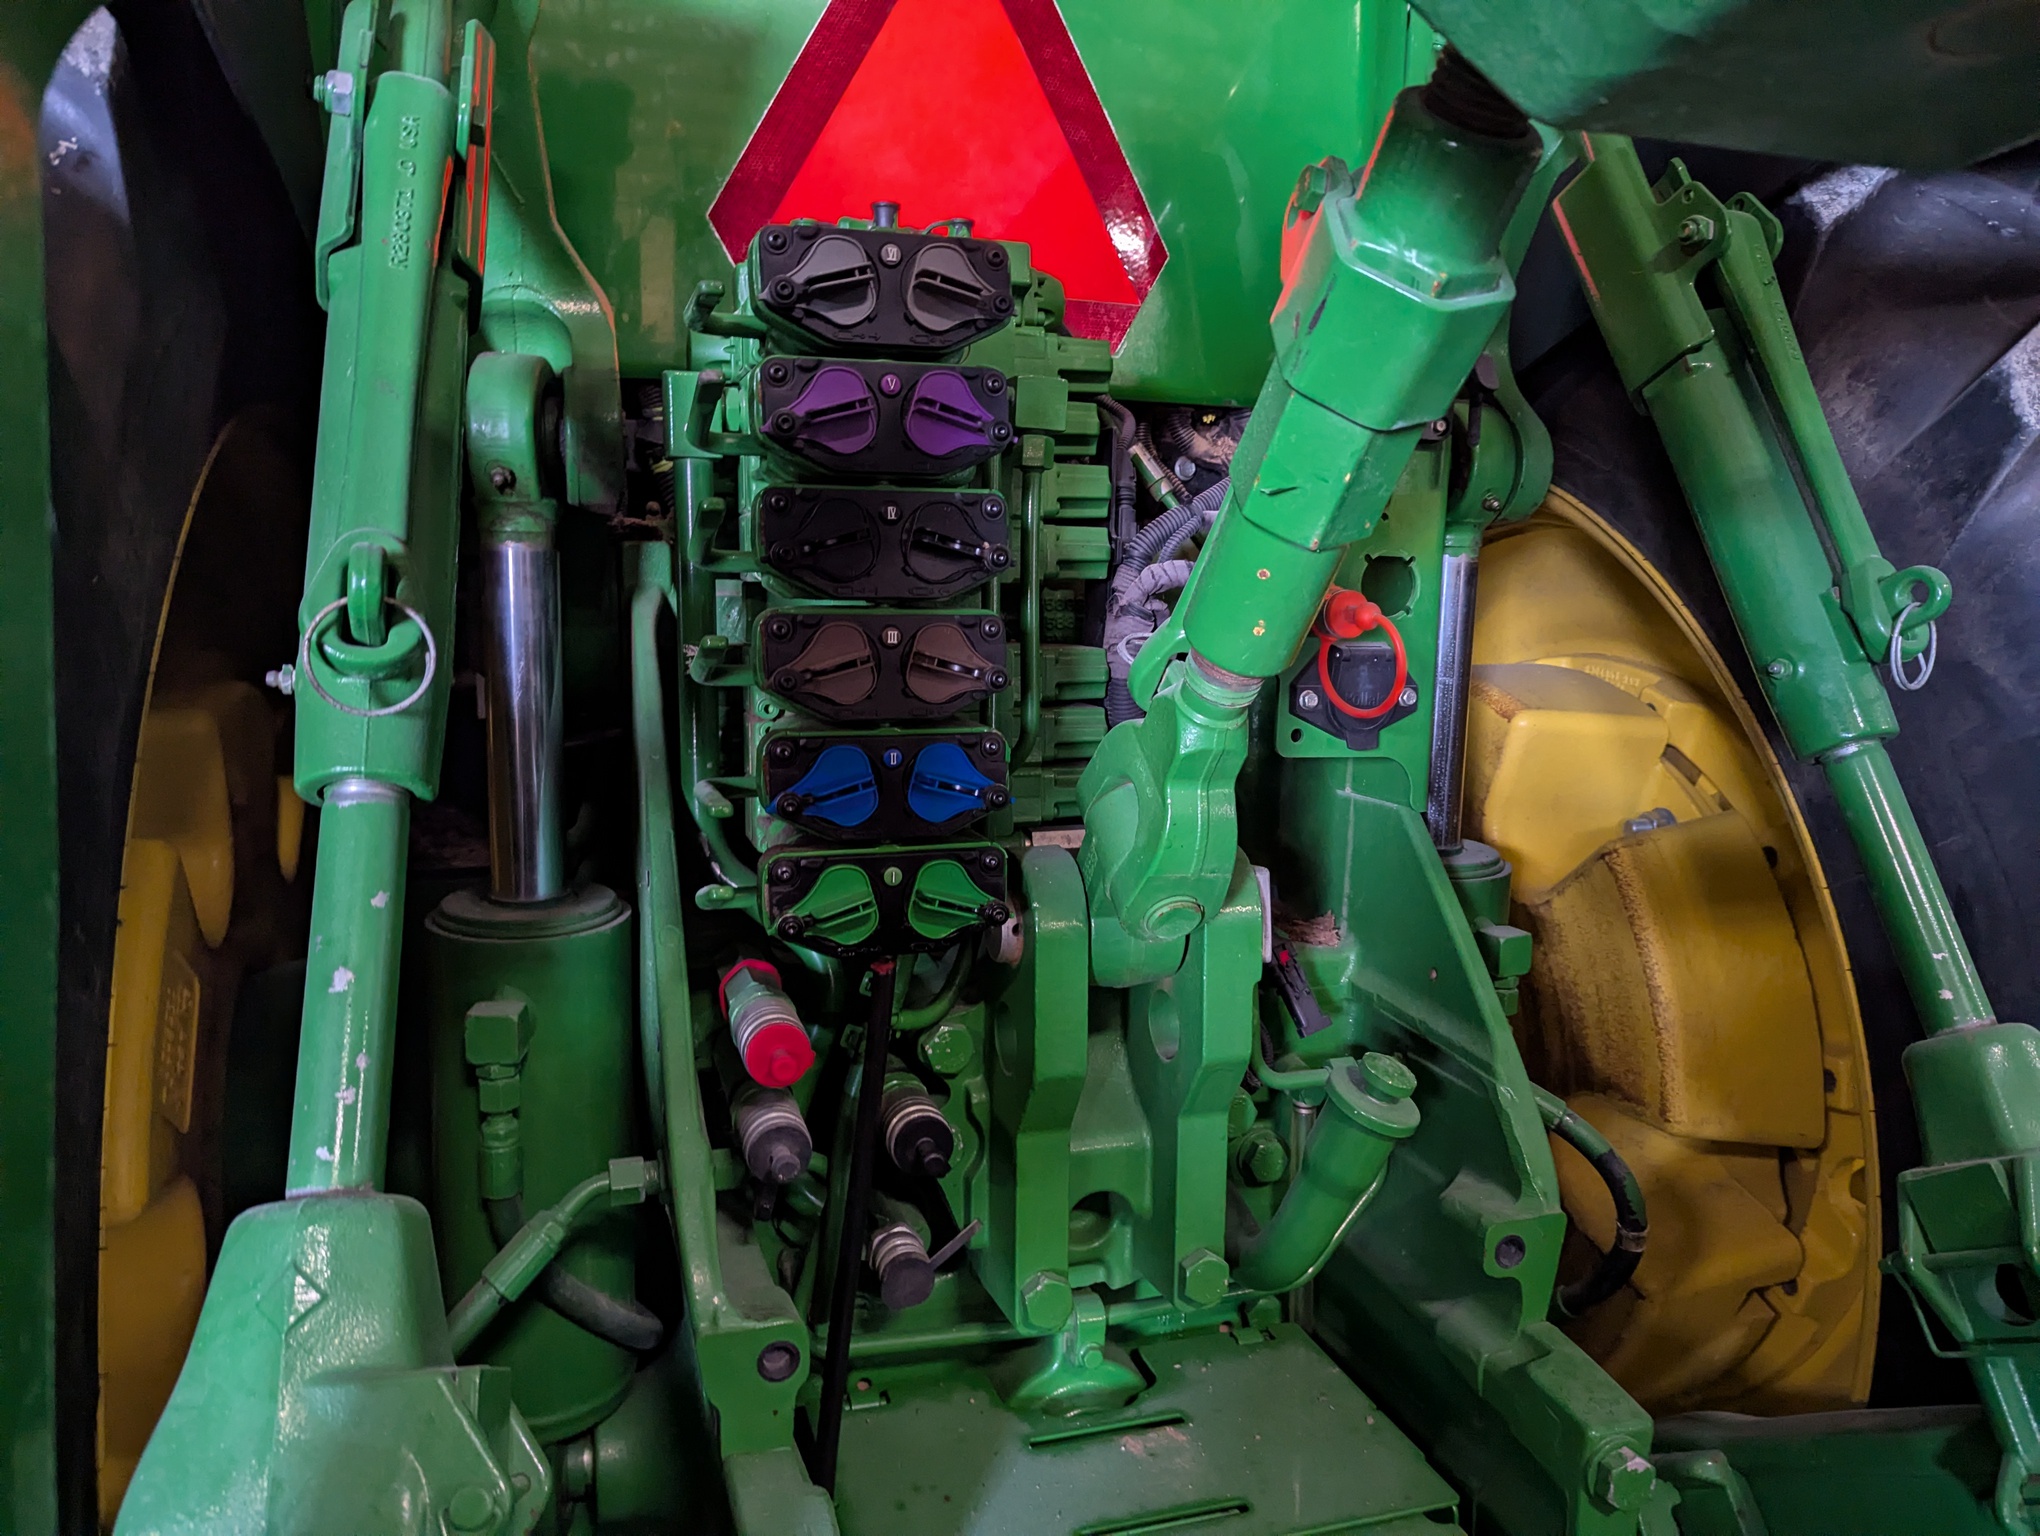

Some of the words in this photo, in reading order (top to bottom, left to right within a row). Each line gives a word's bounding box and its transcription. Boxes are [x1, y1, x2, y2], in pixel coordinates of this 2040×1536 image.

[399, 116, 420, 149] USA
[886, 247, 898, 261] VI
[886, 377, 896, 391] V
[887, 506, 897, 520] IV
[887, 631, 898, 644] III
[890, 752, 897, 765] II
